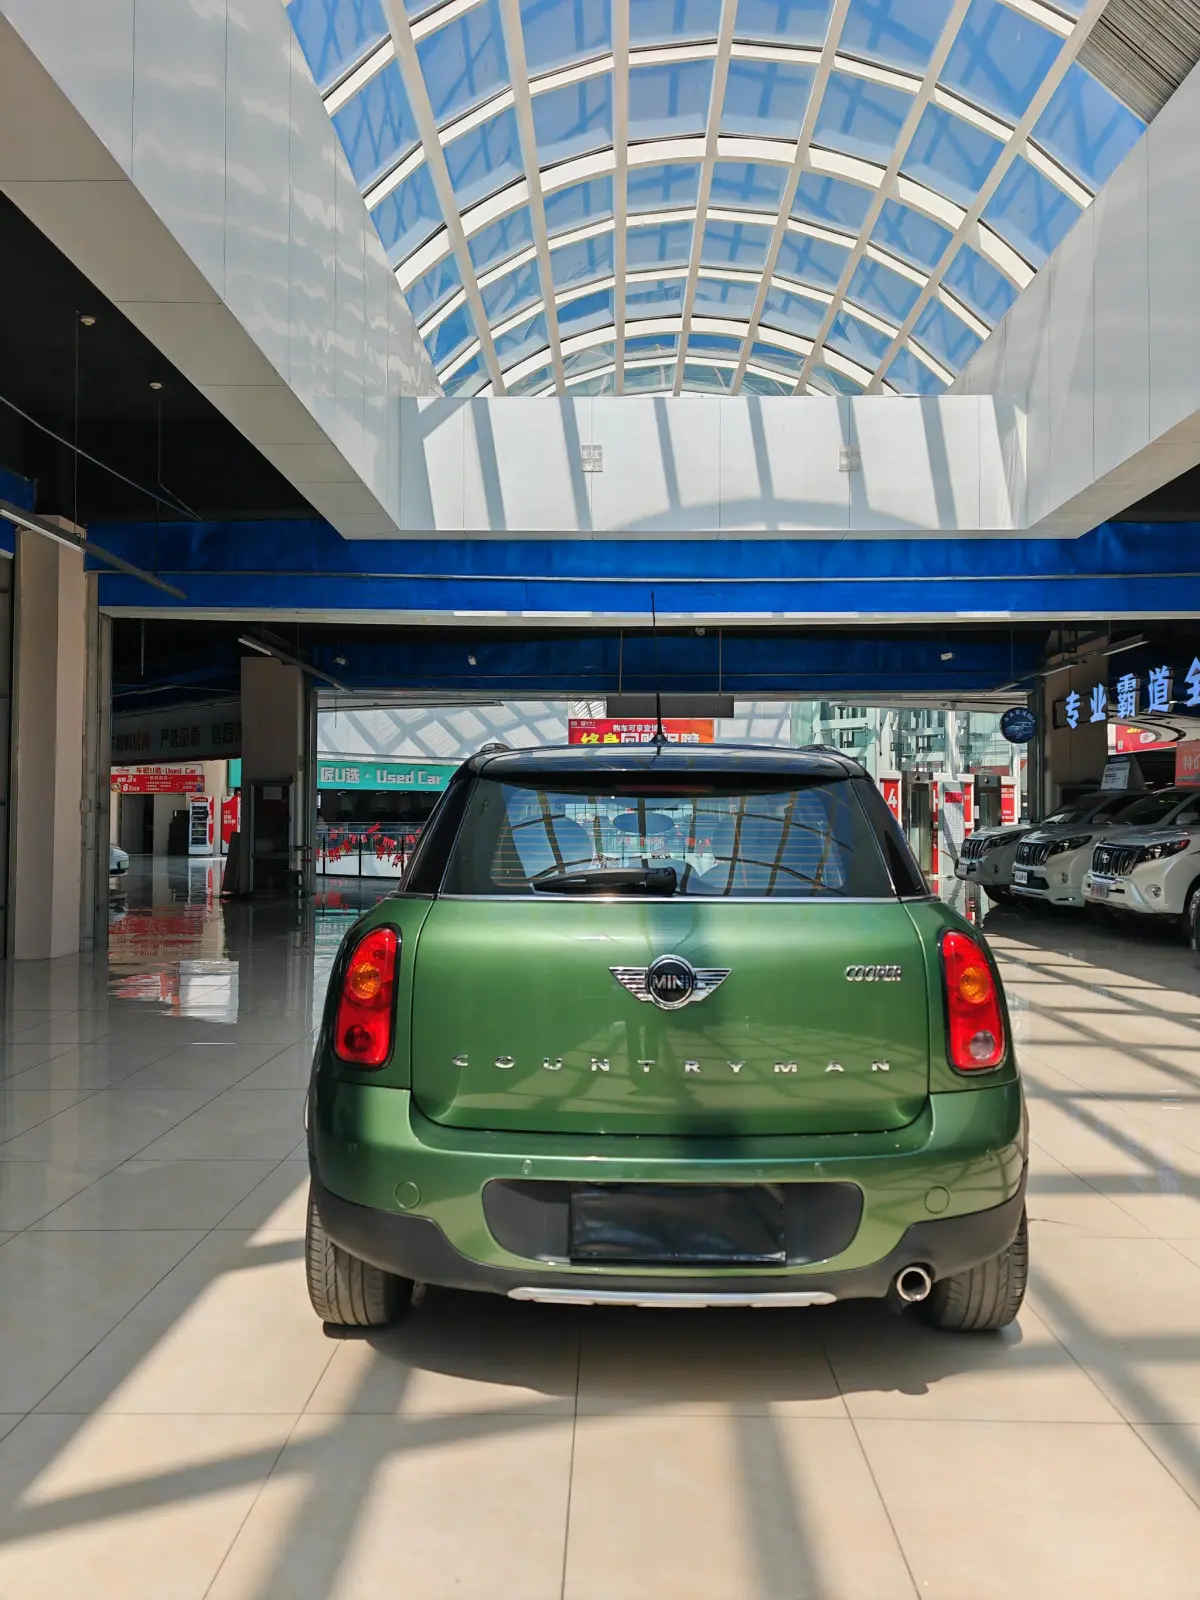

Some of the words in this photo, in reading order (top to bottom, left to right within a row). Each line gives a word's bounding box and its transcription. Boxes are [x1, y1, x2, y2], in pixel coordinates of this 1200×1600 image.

[376, 769, 414, 784] Used
[418, 771, 442, 785] Car
[845, 965, 902, 982] COOPER
[652, 974, 690, 990] MINI
[451, 1053, 891, 1073] COUNTRYMAN
